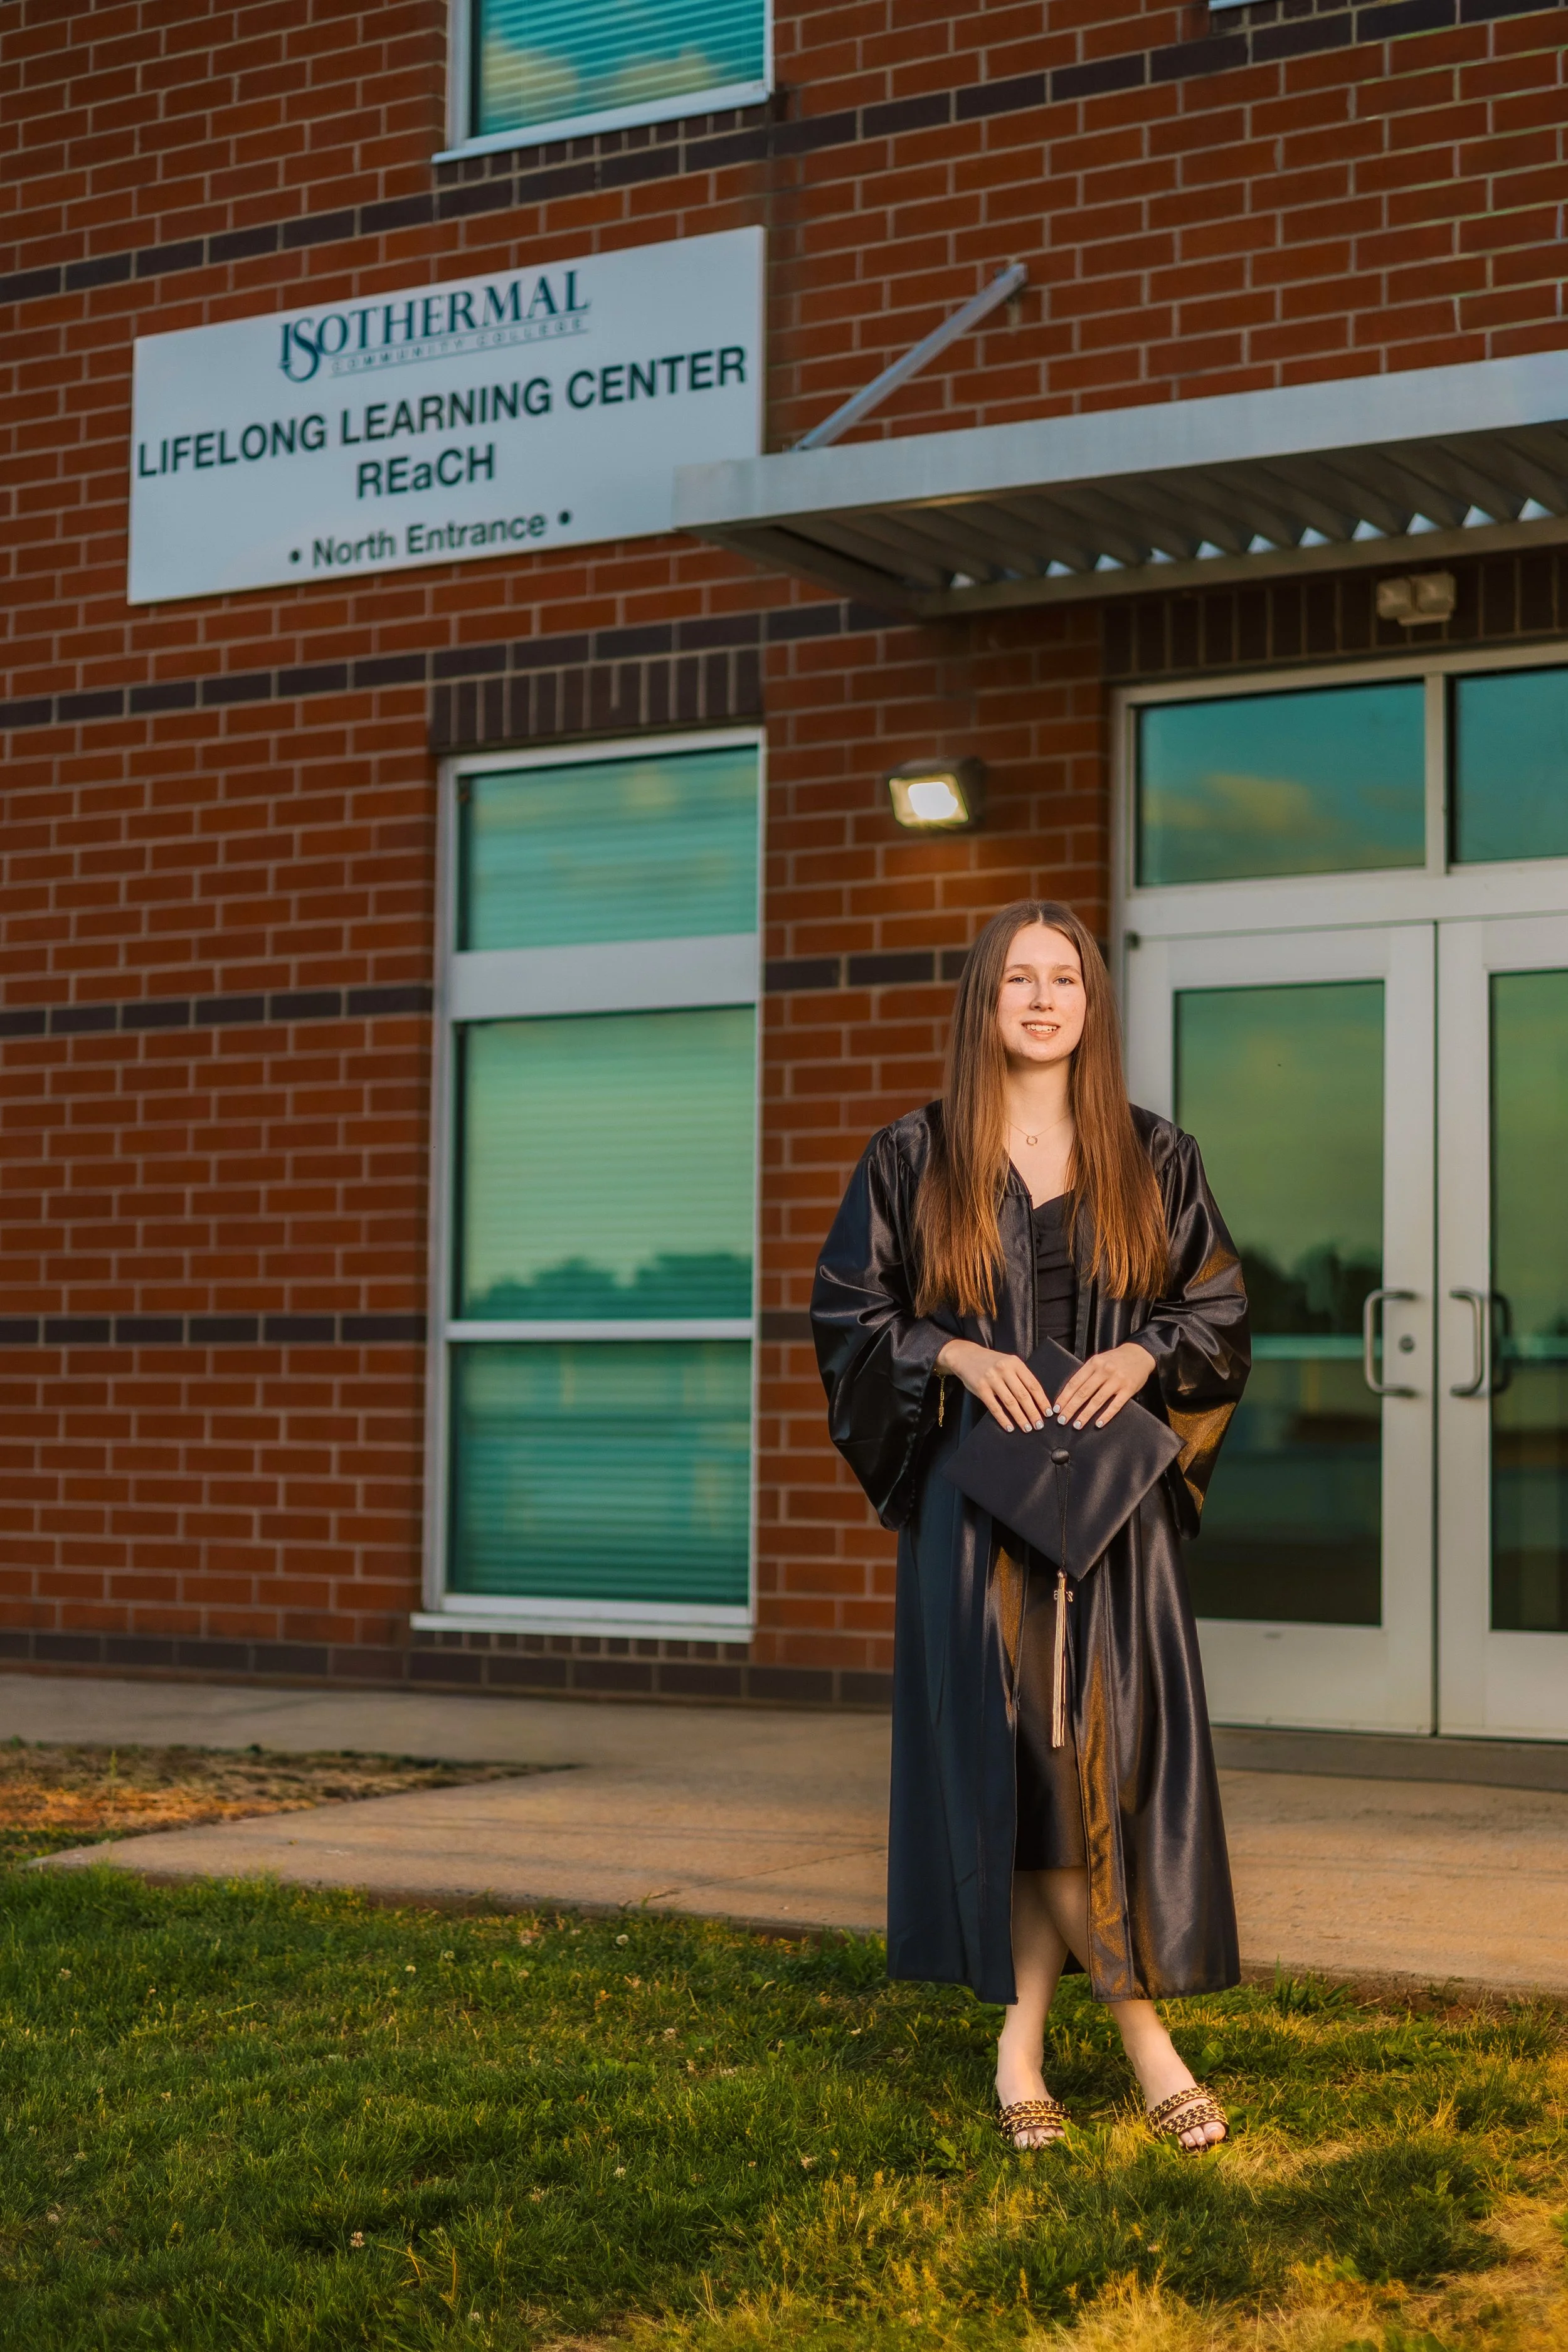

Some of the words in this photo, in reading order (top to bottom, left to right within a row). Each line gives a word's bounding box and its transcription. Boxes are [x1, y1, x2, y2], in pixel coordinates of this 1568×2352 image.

[279, 270, 591, 383] ISOTHERMAL
[477, 318, 581, 345] COLLEGE
[138, 415, 327, 478] LIFELONG
[340, 378, 551, 446] LEARNING
[567, 346, 746, 409] CENTER
[357, 442, 495, 499] REaCH
[312, 529, 396, 568] North
[406, 513, 547, 554] Entrance
